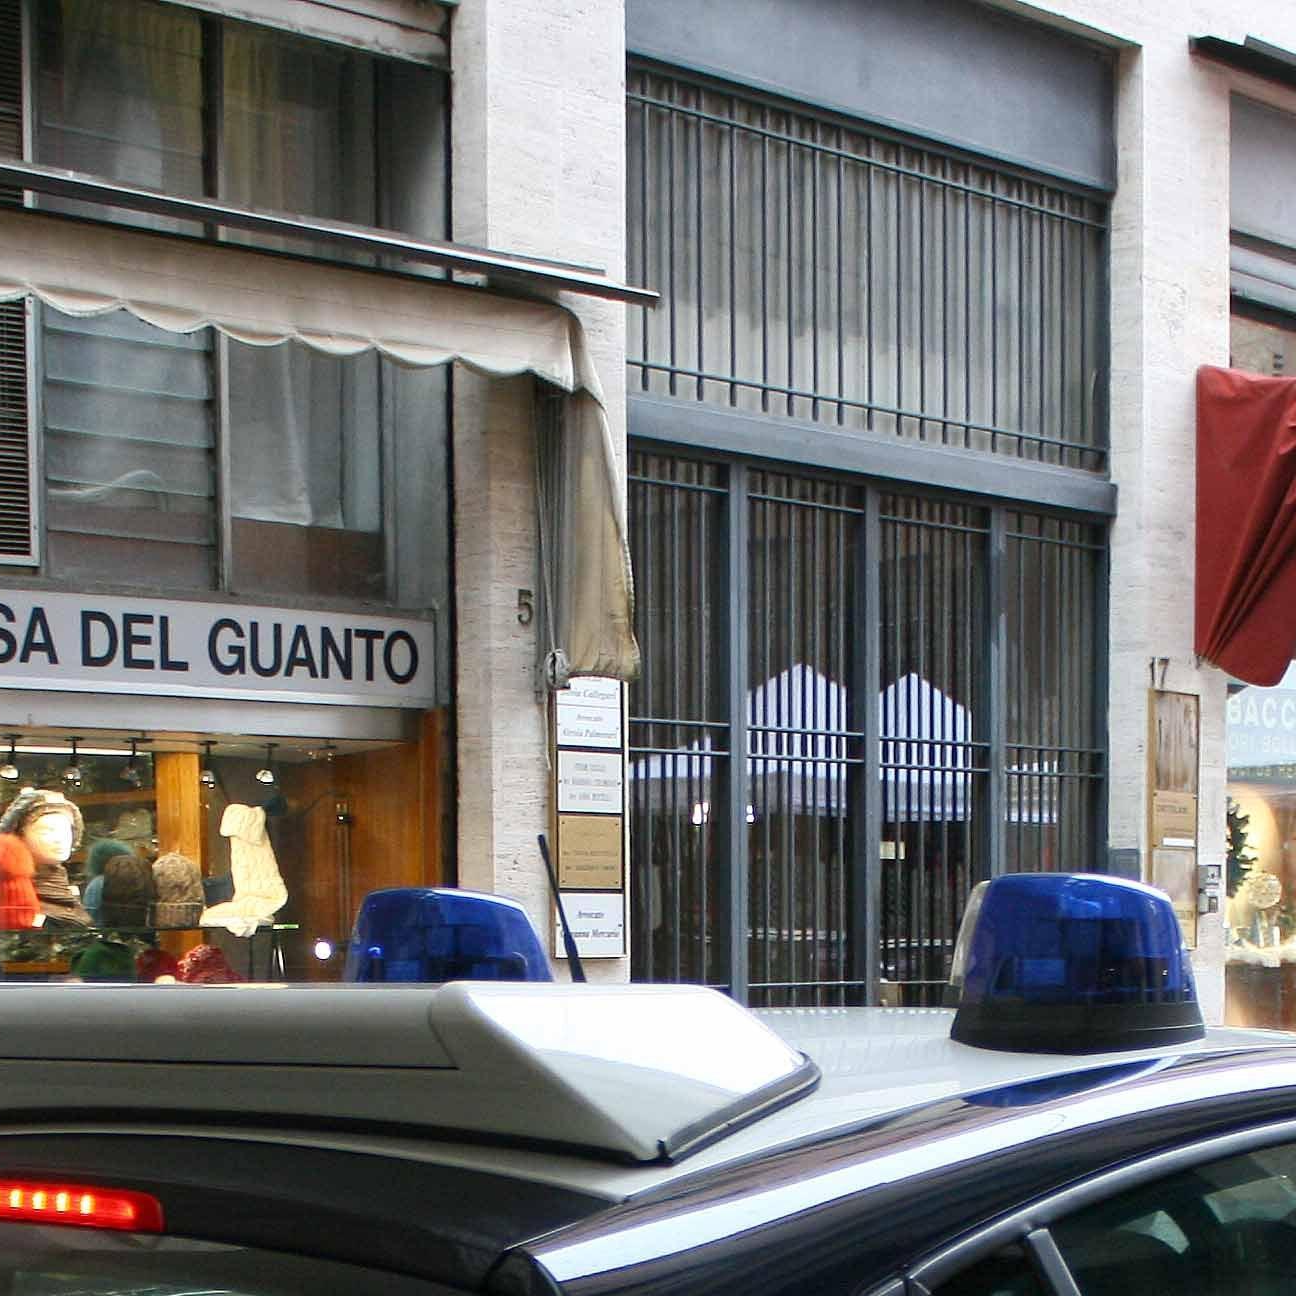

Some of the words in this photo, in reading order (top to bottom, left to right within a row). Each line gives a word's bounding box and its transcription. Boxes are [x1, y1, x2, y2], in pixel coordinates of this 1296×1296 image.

[517, 588, 534, 627] 5
[80, 609, 189, 672] DEL
[207, 617, 419, 685] GUANTO
[1150, 656, 1170, 689] 17
